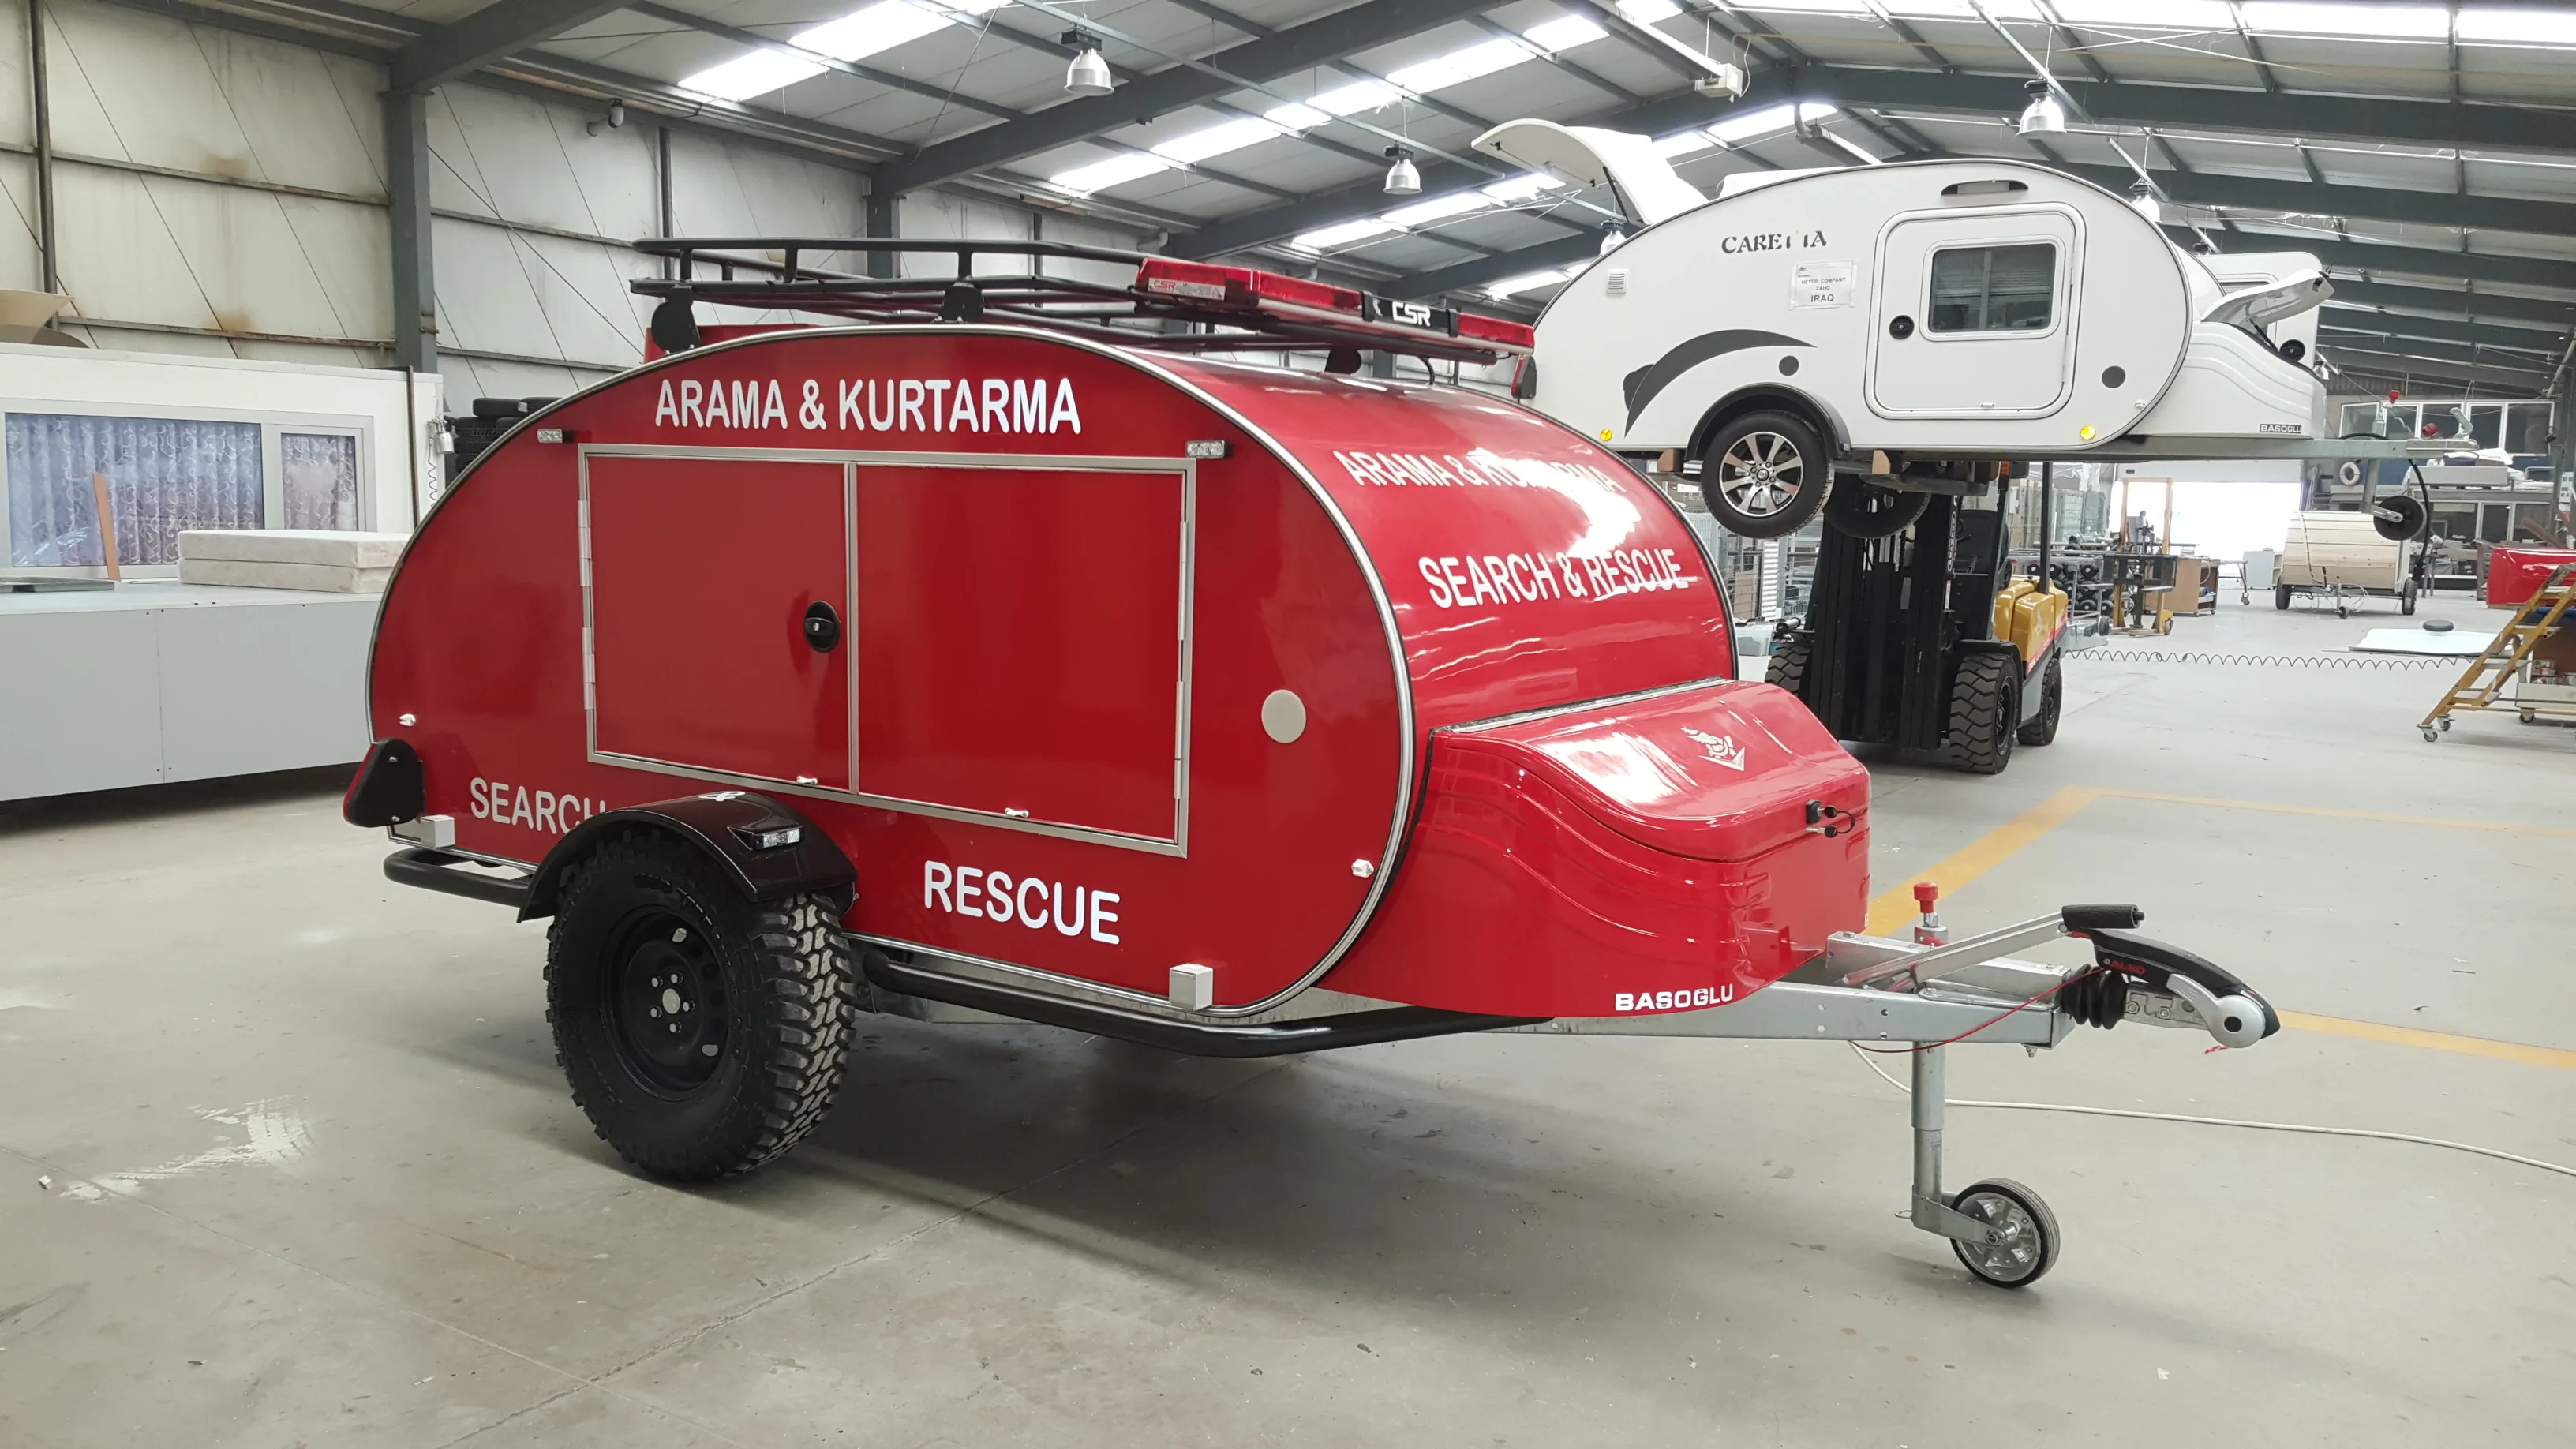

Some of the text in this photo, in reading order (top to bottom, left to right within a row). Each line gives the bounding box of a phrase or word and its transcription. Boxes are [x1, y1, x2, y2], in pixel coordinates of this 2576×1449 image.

[1392, 301, 1431, 327] CSR
[1810, 294, 1835, 302] IRAQ
[655, 378, 1081, 434] ARAMA & KURTARMA
[1333, 451, 1464, 486] ARAMA
[1443, 455, 1490, 486] &
[1418, 549, 1689, 608] SEARCH & RESCUE
[925, 860, 1121, 945] RESCUE
